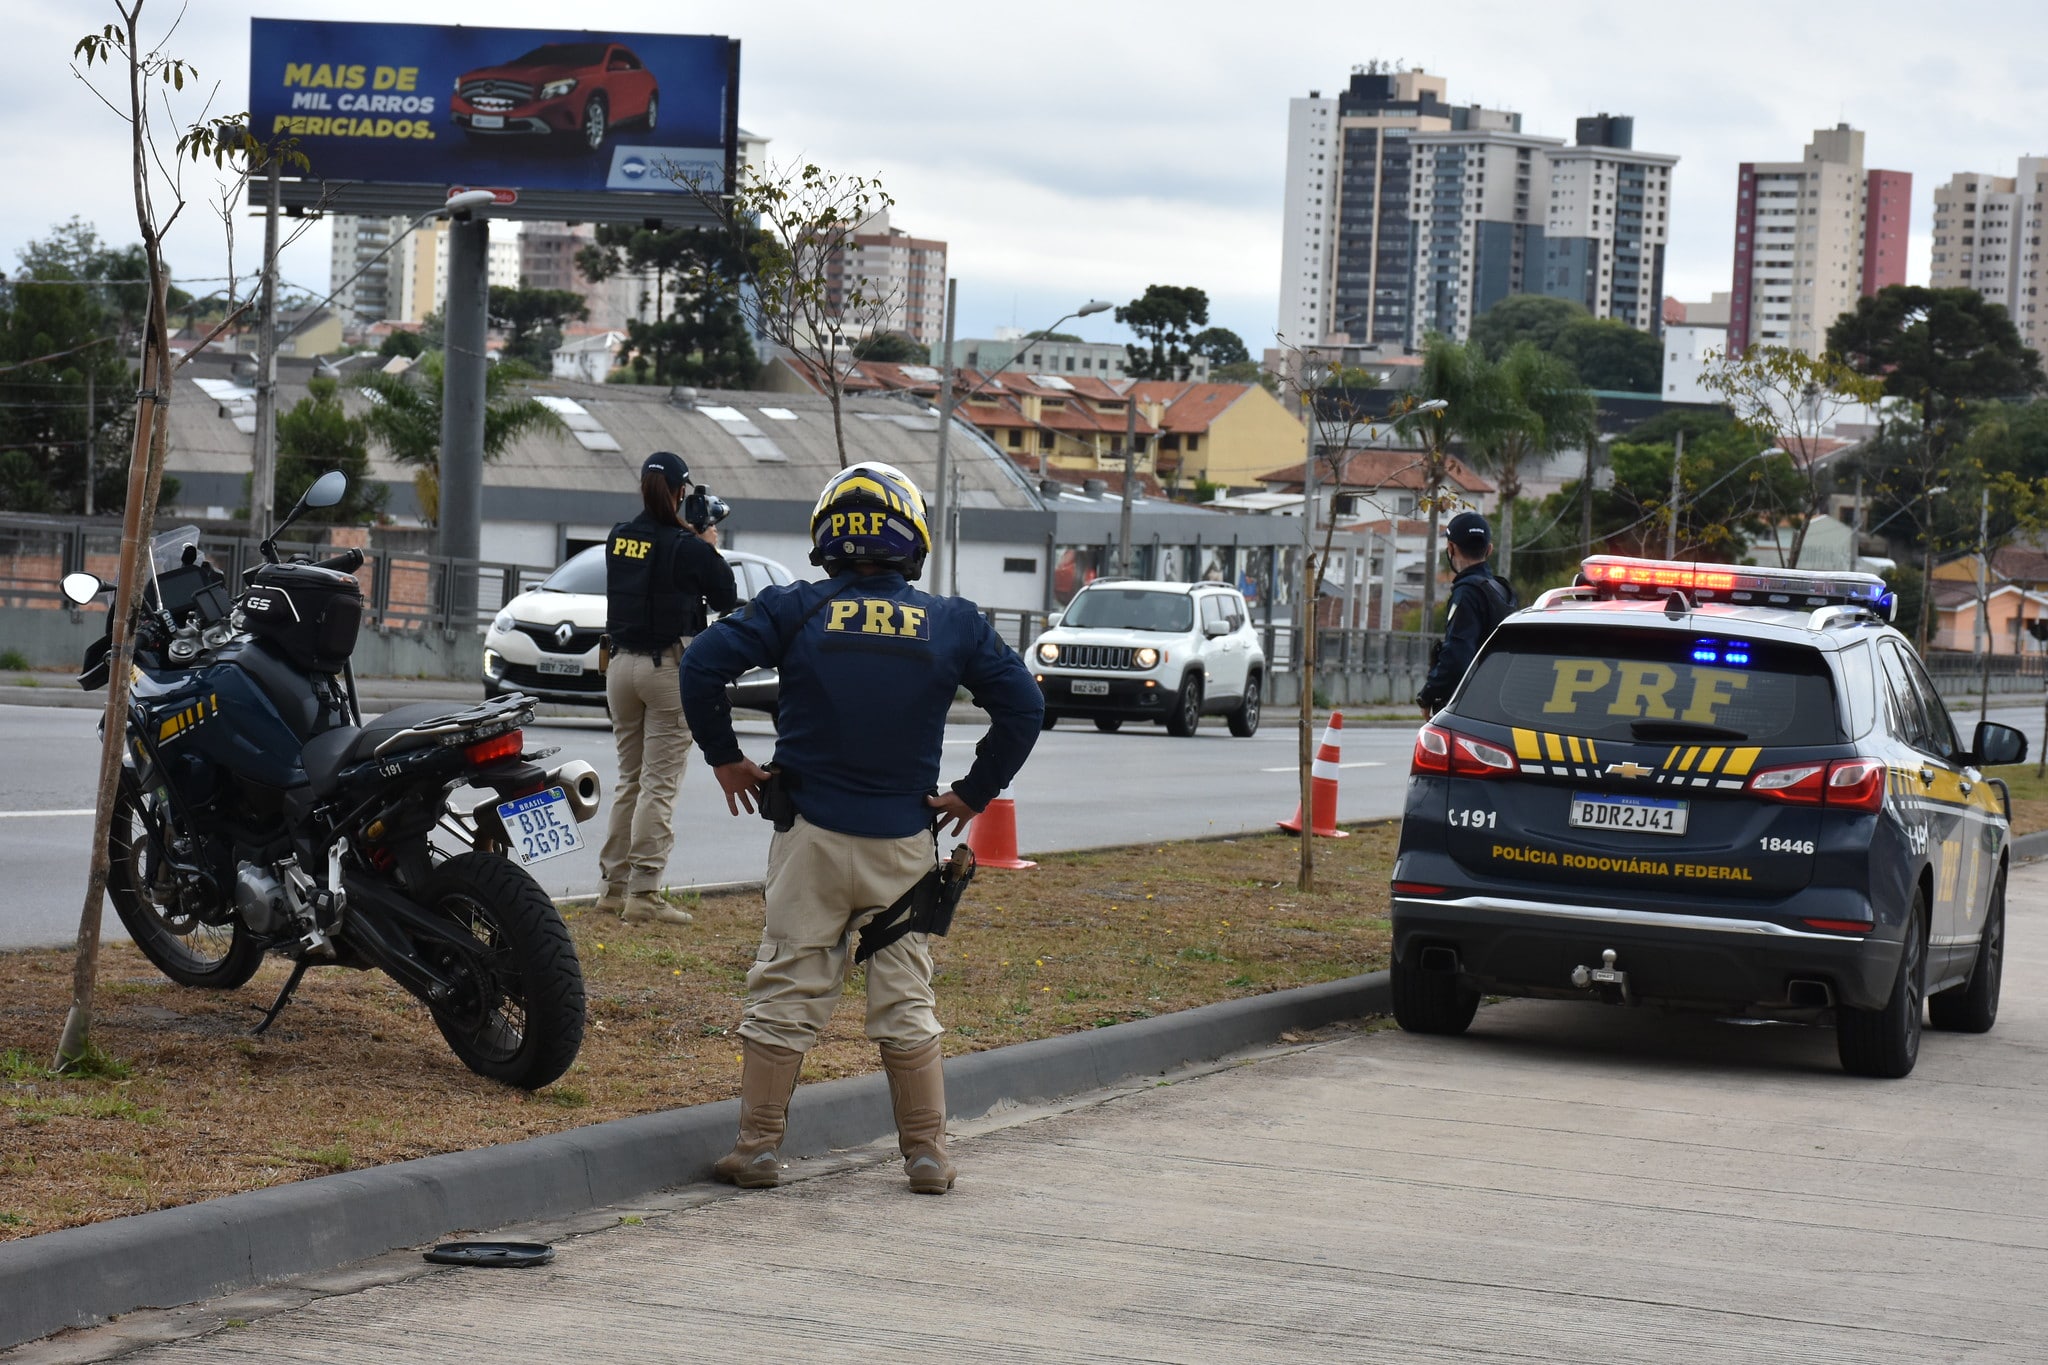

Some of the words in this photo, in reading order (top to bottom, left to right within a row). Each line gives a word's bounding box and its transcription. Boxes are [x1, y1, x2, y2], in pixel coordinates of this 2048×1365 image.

[283, 62, 366, 90] MAIS
[372, 65, 419, 91] DE
[292, 92, 332, 110] MIL
[337, 93, 435, 114] CARROS
[272, 115, 436, 139] PERICIADOS.
[831, 512, 887, 537] PRF
[613, 537, 651, 559] PRF
[247, 597, 271, 610] GS
[827, 600, 925, 636] PRF
[1542, 659, 1749, 725] PRF
[385, 762, 402, 776] 191
[519, 798, 545, 811] BRASIL
[1582, 803, 1674, 830] BDR2J41
[518, 804, 560, 835] BDE
[1460, 809, 1497, 829] 191
[523, 824, 575, 858] 2G93
[1760, 836, 1815, 854] 18446
[1492, 845, 1558, 865] POLÍCIA
[1562, 853, 1669, 876] RODOVIÁRIA
[1674, 863, 1752, 880] FEDERAL
